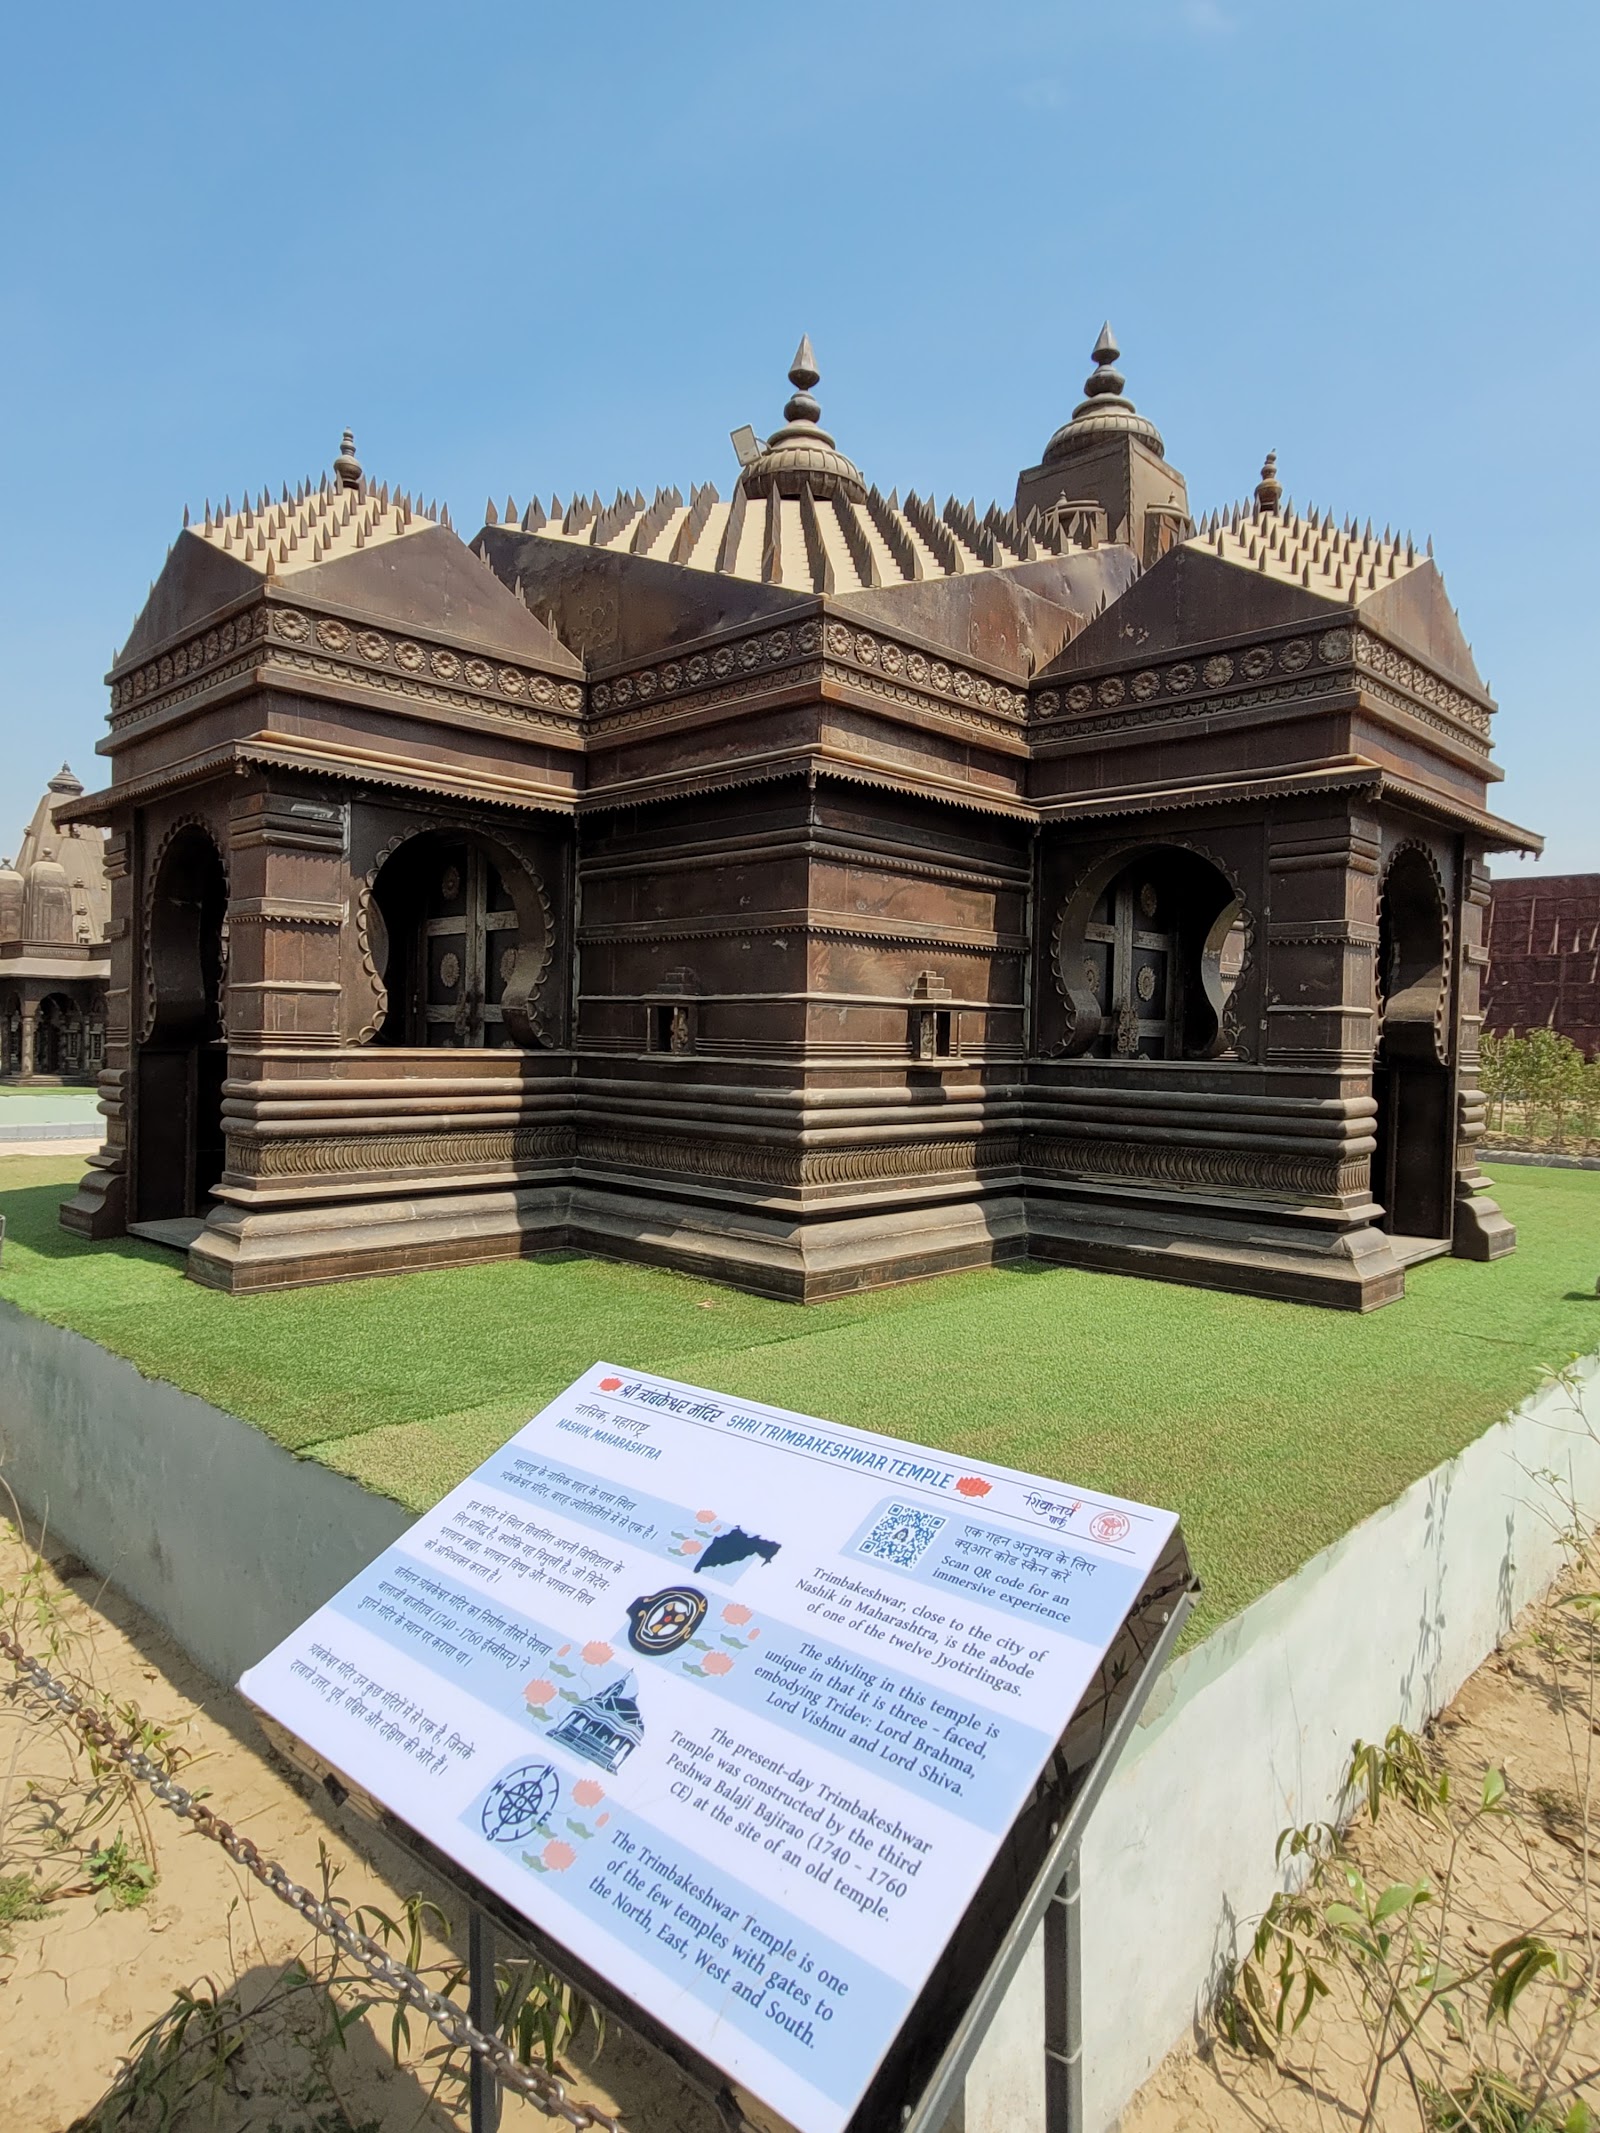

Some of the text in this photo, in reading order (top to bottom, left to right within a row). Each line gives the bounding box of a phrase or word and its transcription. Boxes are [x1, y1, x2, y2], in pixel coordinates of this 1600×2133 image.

[555, 1417, 662, 1460] NASHIK, MAHARASHTRA
[619, 1383, 642, 1398] श्री
[686, 1402, 725, 1423] मंदिर
[726, 1414, 954, 1489] SHRI TRIMBAKESHWAR TEMPLE
[931, 1567, 1070, 1622] immersive experience
[940, 1555, 1069, 1606] Scan QR code for an
[954, 1538, 1072, 1583] क्यूआर कोड स्कैन करें
[963, 1524, 1097, 1576] एक गहन अनुभव के लिए
[795, 1578, 1034, 1678] Nashik in Maharashtra, is the abode
[806, 1602, 1021, 1696] of one of the twelve Jyotirlingas.
[813, 1567, 1049, 1662] Trimbakeshwar, close to the city of
[754, 1666, 974, 1779] embodying Tridev: Lord Brahma,
[764, 1650, 807, 1674] unique
[808, 1667, 823, 1682] in
[826, 1675, 855, 1696] that
[856, 1688, 870, 1703] it
[871, 1695, 886, 1710] is
[888, 1703, 927, 1729] three
[942, 1726, 987, 1759] faced,
[798, 1642, 1000, 1738] The shivling in this temple is
[490, 1779, 507, 1796] W
[540, 1764, 555, 1780] N
[710, 1727, 932, 1853] The present-day Trimbakeshwar
[765, 1690, 962, 1796] Lord Vishnu and Lord Shiva.
[486, 1826, 500, 1842] S
[537, 1810, 553, 1827] E
[665, 1752, 712, 1787] Peshwa
[712, 1779, 754, 1810] Balaji
[752, 1801, 804, 1839] Bajirao
[806, 1832, 850, 1865] (1740
[866, 1867, 907, 1897] 1760
[670, 1729, 922, 1876] Temple was constructed by the third
[669, 1781, 888, 1922] CE) at the site of an old temple.
[606, 1860, 833, 2021] of the few temples with gates to
[611, 1829, 848, 1996] The Trimbakeshwar Temple is one
[588, 1875, 813, 2048] the North, East, West and South.
